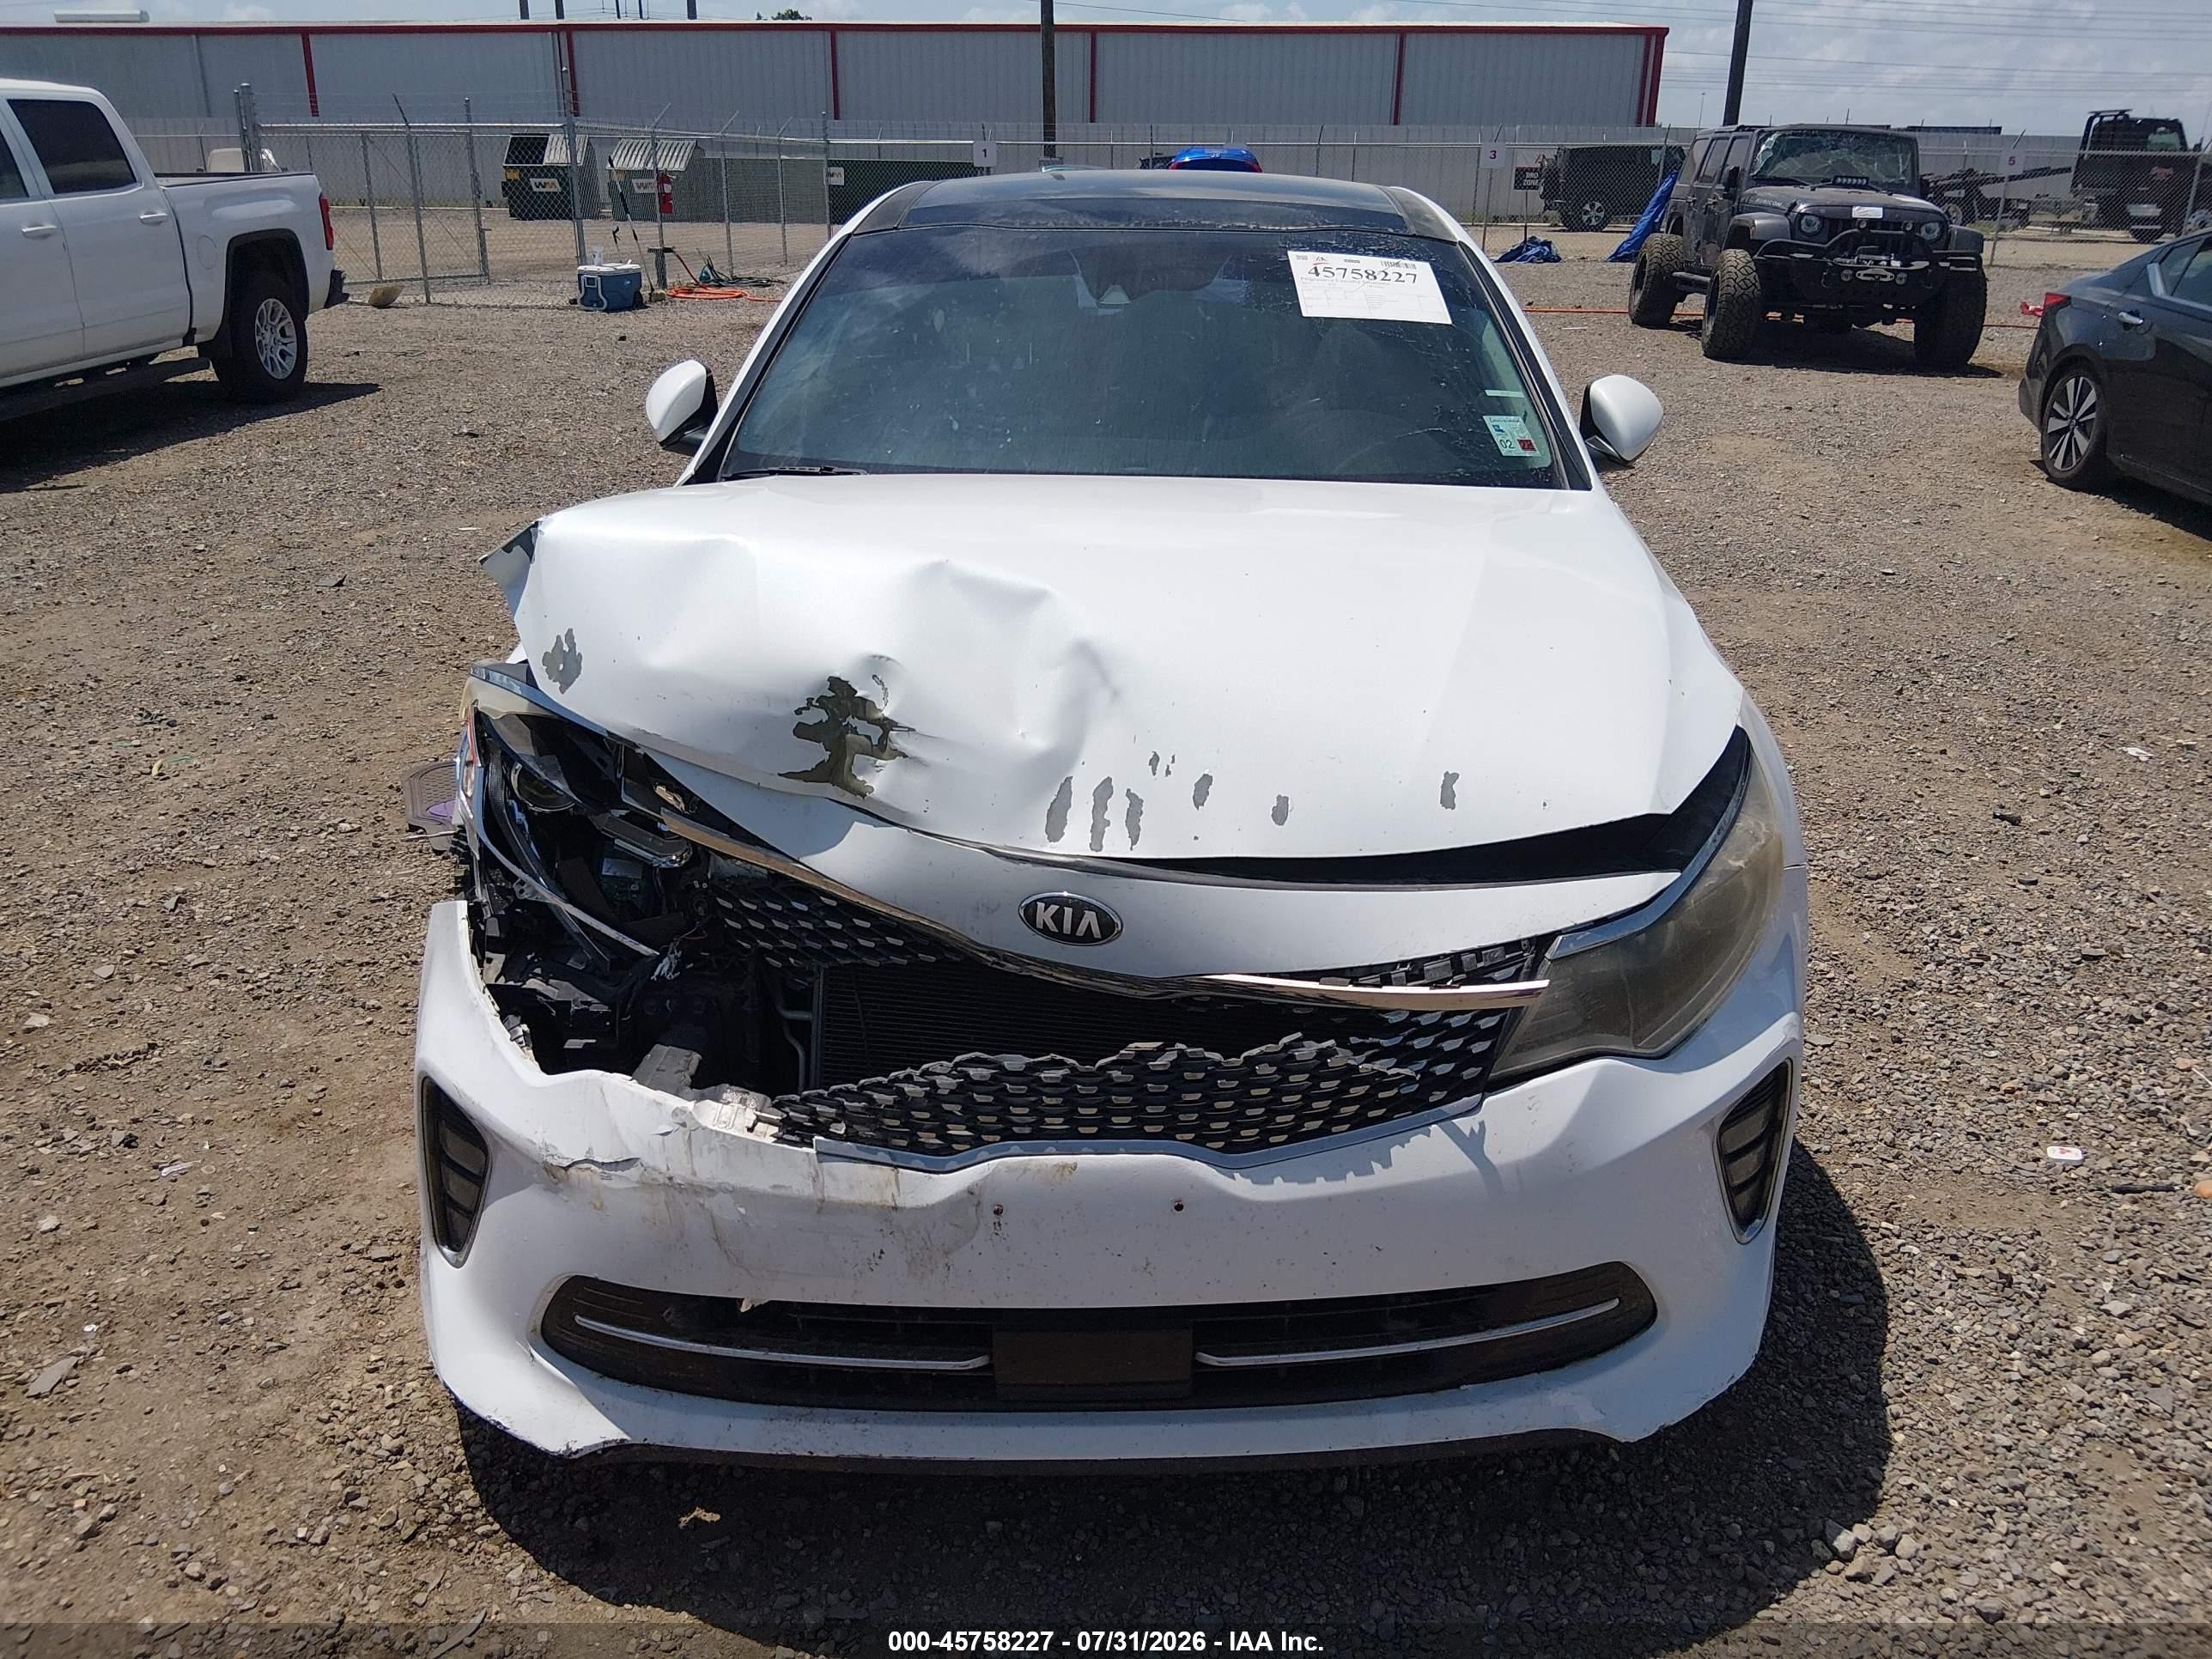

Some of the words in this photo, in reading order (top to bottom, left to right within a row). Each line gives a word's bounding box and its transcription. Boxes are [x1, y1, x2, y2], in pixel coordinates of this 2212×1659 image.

[982, 149, 988, 158] 1
[1489, 149, 1497, 160] 3
[1756, 198, 1783, 207] RUBICON
[1308, 266, 1417, 283] 45758227
[1499, 440, 1516, 449] 02
[1036, 902, 1102, 939] KIA
